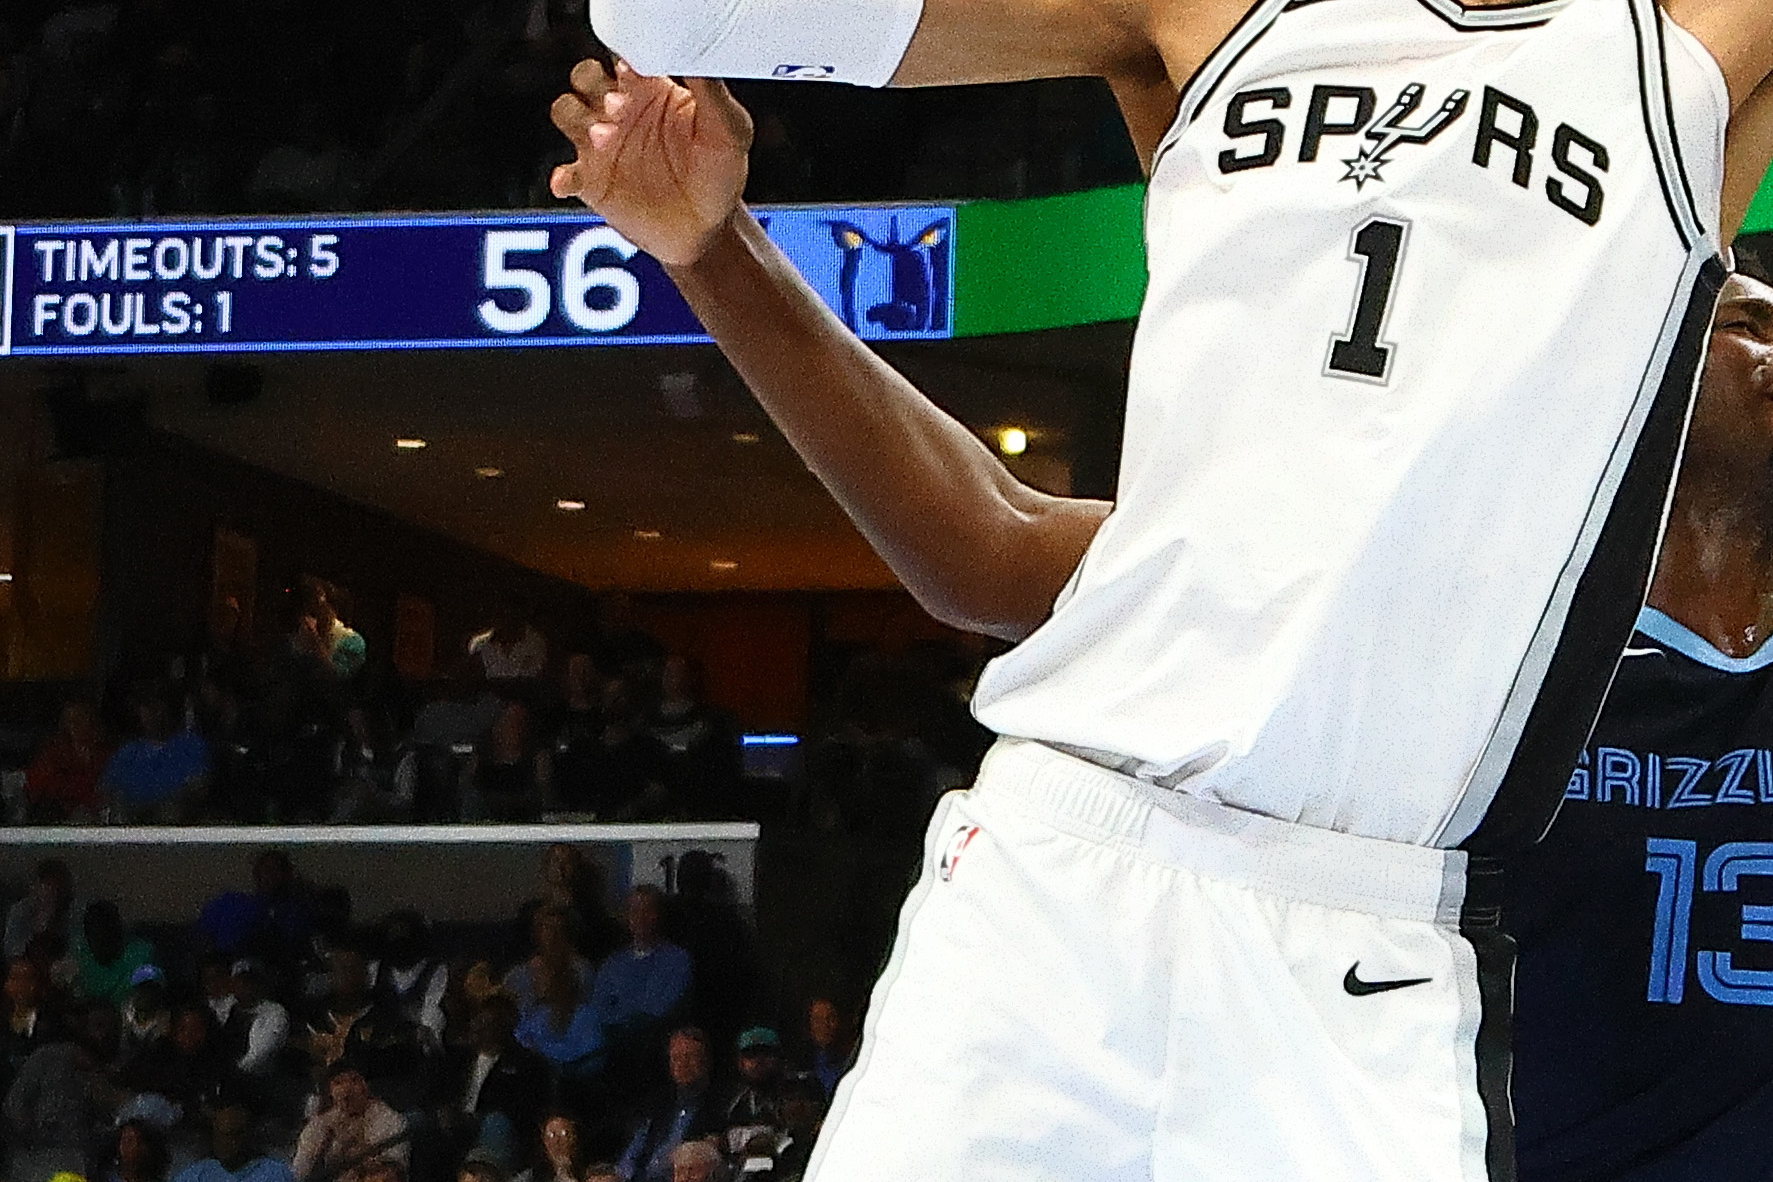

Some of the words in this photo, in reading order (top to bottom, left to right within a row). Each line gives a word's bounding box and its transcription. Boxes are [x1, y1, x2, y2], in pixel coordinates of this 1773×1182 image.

[1218, 82, 1610, 227] SPURS
[35, 235, 298, 282] TIMEOUTS:
[309, 233, 339, 278] 5
[477, 228, 641, 333] 56
[1321, 214, 1412, 386] 1
[33, 290, 205, 336] FOULS:
[215, 291, 231, 331] 1
